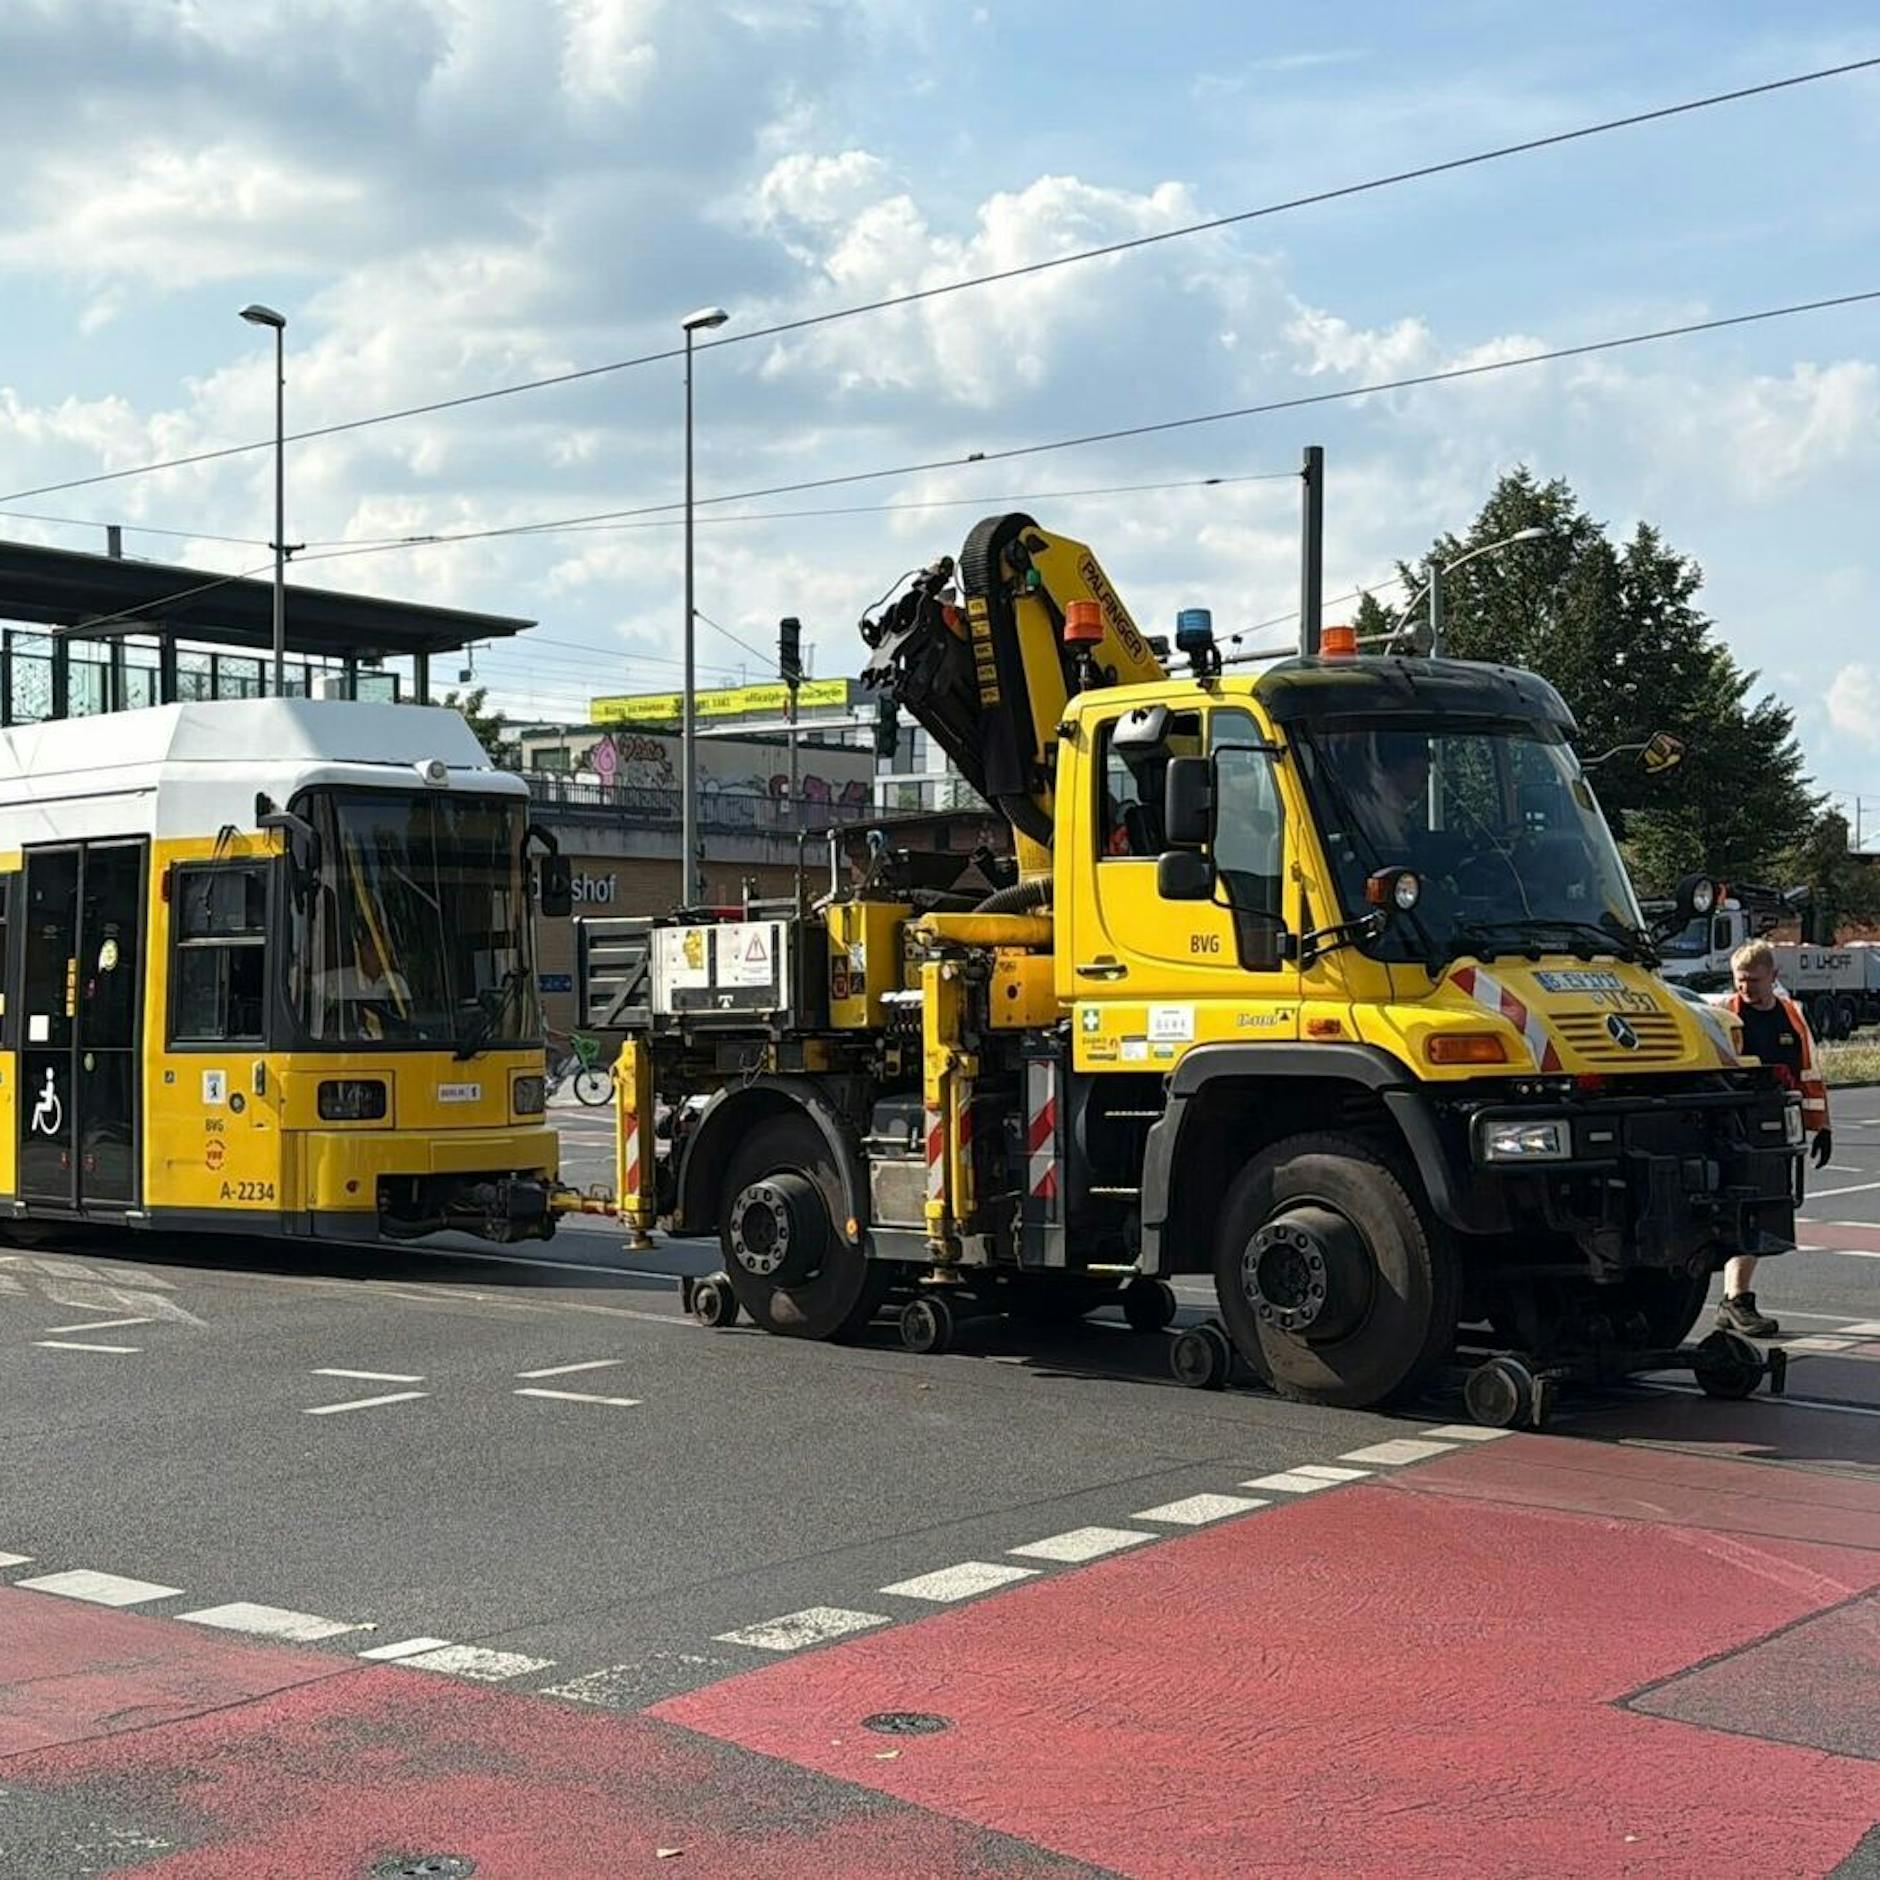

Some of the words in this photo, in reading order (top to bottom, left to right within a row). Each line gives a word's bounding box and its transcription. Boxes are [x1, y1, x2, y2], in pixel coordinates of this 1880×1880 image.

[1082, 560, 1142, 658] PALFINGER
[1190, 934, 1219, 953] BVG
[220, 1181, 275, 1200] A-2234
